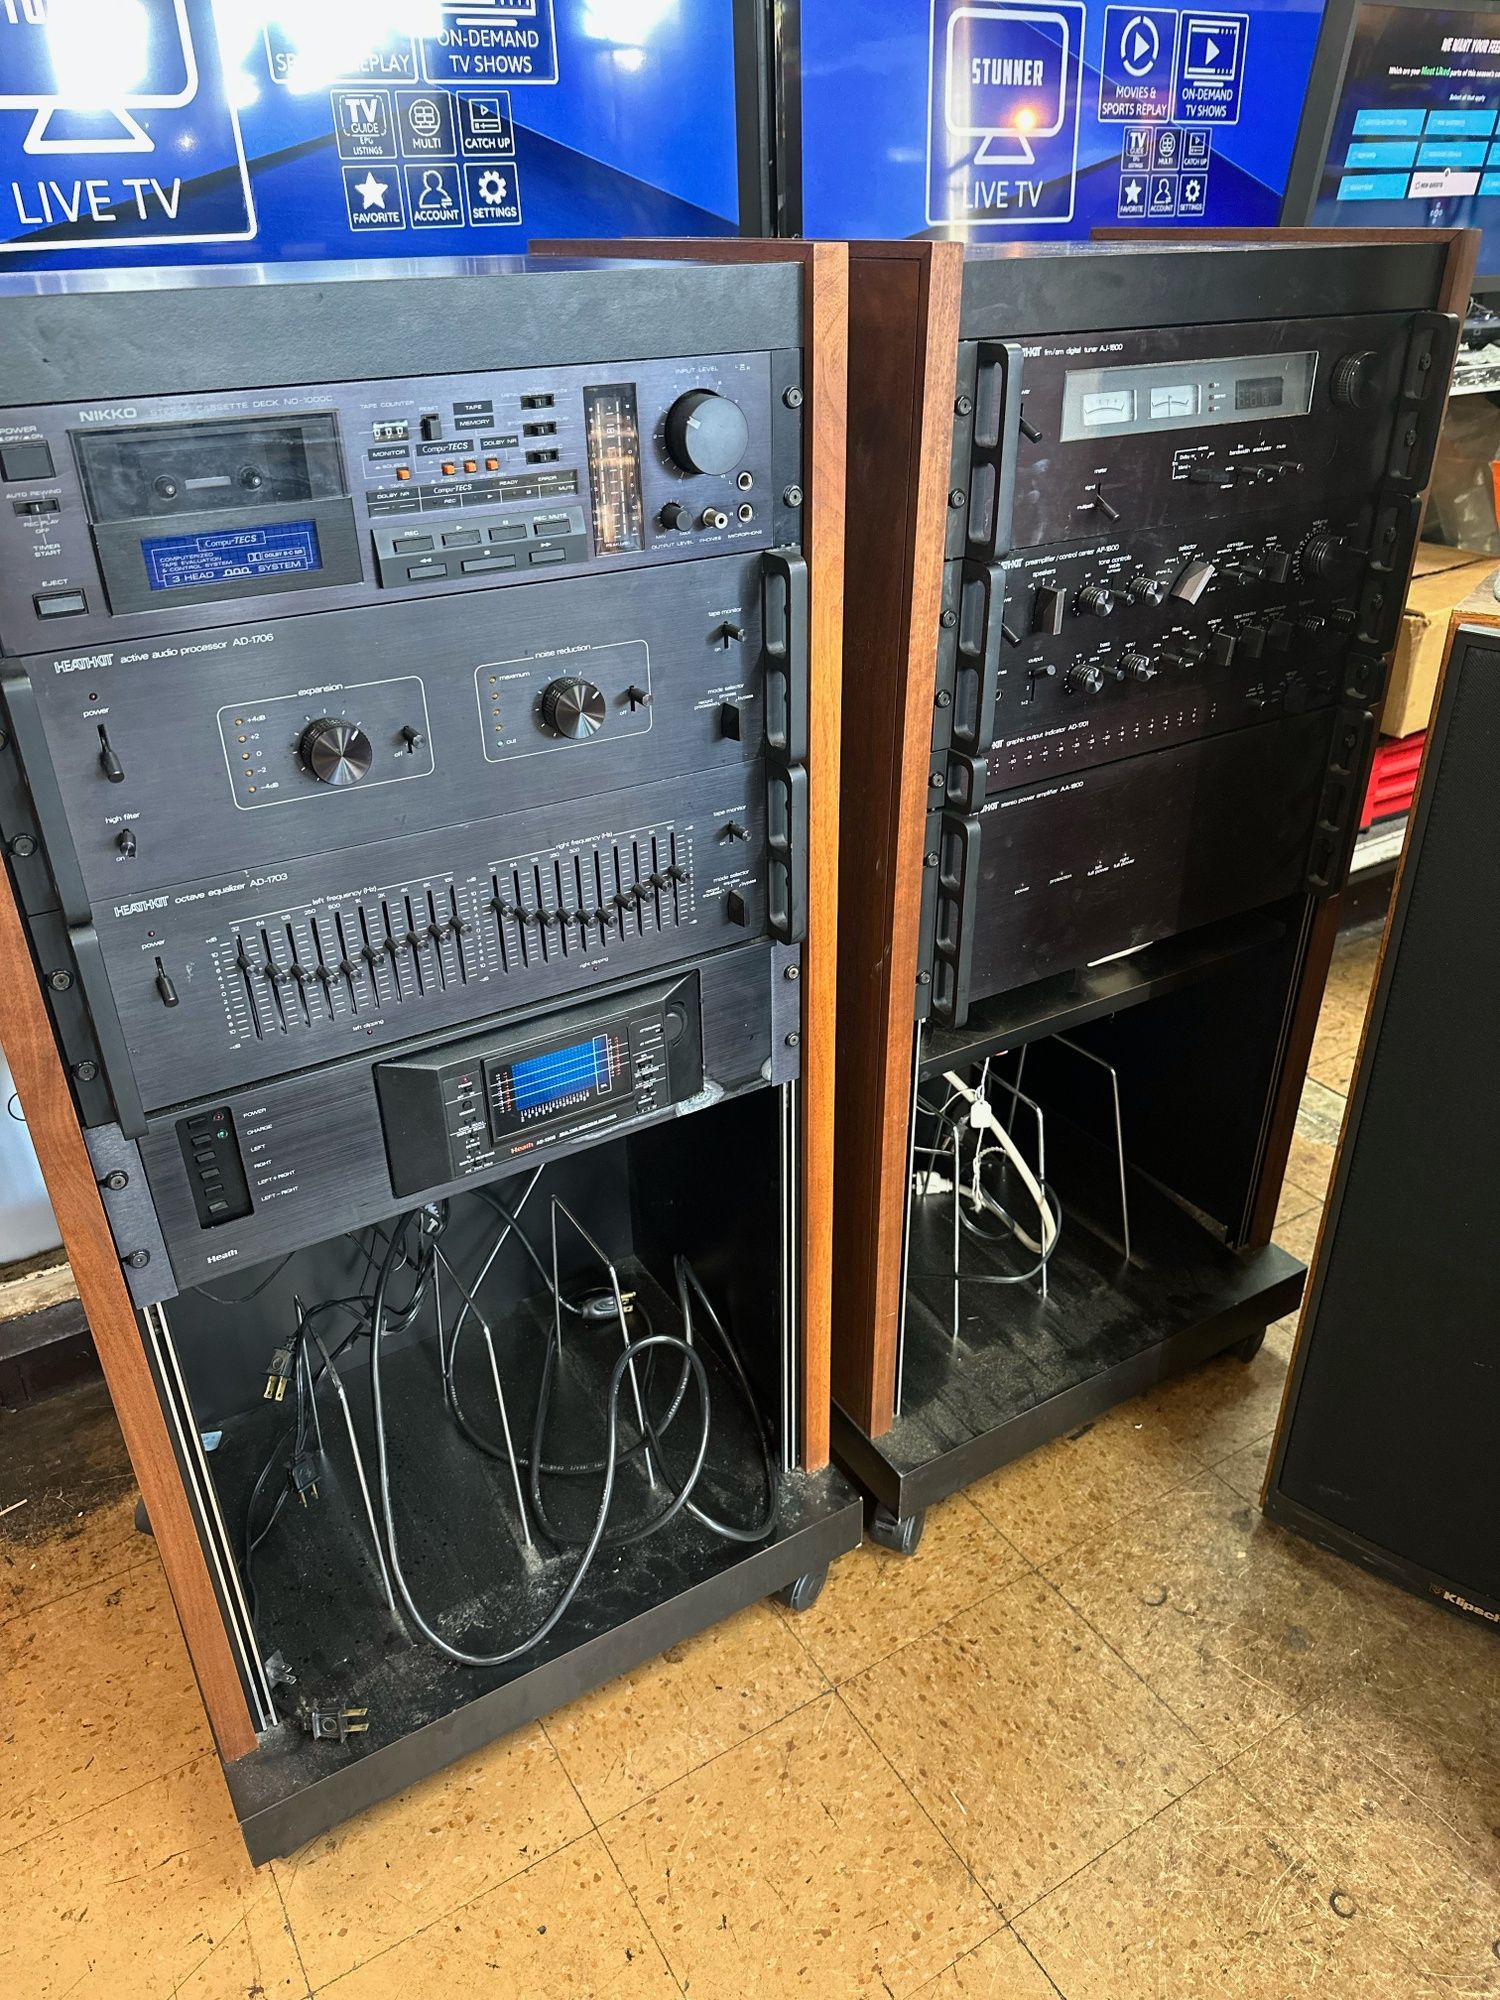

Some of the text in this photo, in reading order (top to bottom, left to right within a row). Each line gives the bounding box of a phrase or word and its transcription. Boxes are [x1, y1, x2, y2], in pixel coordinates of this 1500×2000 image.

[437, 30, 539, 48] ON-DEMAND
[449, 55, 533, 74] TV SHOWS
[971, 60, 1044, 86] STUNNER
[1116, 86, 1157, 99] MOVIES &
[1182, 88, 1233, 101] ON-DEMAND
[345, 98, 377, 122] TV
[1102, 103, 1167, 116] SPORTS REPLAY
[1186, 105, 1227, 117] TV SHOWS
[351, 123, 379, 134] GUIDE
[413, 138, 441, 149] MULTI
[465, 138, 511, 150] CATCH UP
[1129, 132, 1146, 148] TV
[353, 147, 383, 156] LISTINGS
[1184, 158, 1199, 166] CATCH
[12, 178, 181, 224] LIVE TV
[962, 180, 1043, 210] LIVE TV
[353, 212, 400, 224] FAVORITE
[414, 210, 459, 222] ACCOUNT
[472, 207, 517, 219] SETTINGS
[79, 407, 138, 422] NIKKO
[198, 402, 248, 412] CASSETTE
[253, 399, 279, 408] DECK
[380, 400, 415, 408] COUNTER
[0, 425, 37, 434] POWER
[459, 419, 490, 427] MEMORY
[372, 449, 406, 458] MONITOR
[6, 488, 62, 499] AUTO REWIND
[33, 543, 61, 552] TIMER
[34, 550, 61, 558] START
[160, 552, 214, 562] COMPUTERIZED
[161, 557, 222, 568] TAPE EVALUATION
[1025, 556, 1056, 568] preamplifier
[1059, 551, 1078, 561] control
[169, 564, 204, 573] CONTROL
[205, 560, 233, 569] SYSTEM
[172, 561, 301, 583] 3 HEAD SYSTEM
[42, 579, 68, 587] EJECT
[708, 607, 742, 618] tape monitor
[120, 651, 149, 664] active
[151, 648, 178, 660] audio
[180, 641, 228, 656] processor
[232, 633, 275, 647] AD-1706
[535, 644, 592, 659] noise reduction
[499, 671, 531, 681] maximum
[298, 683, 344, 697] expansion
[83, 707, 109, 719] power
[105, 811, 141, 825] high filter
[555, 840, 570, 850] right
[571, 834, 600, 847] frequency
[174, 891, 205, 904] octave
[207, 883, 246, 898] equalizer
[250, 873, 288, 888] AD-1703
[312, 896, 325, 906] left
[326, 889, 363, 902] frequency
[141, 938, 166, 951] power
[243, 1107, 267, 1119] POWER
[246, 1123, 273, 1136] CHARGE
[250, 1143, 266, 1153] LEFT
[510, 1141, 534, 1154] Heath
[254, 1159, 272, 1169] RIGHT
[257, 1176, 273, 1186] LEFT
[278, 1169, 296, 1180] RIGHT
[261, 1185, 299, 1202] LEFT RIGHT
[207, 1249, 238, 1264] Heath
